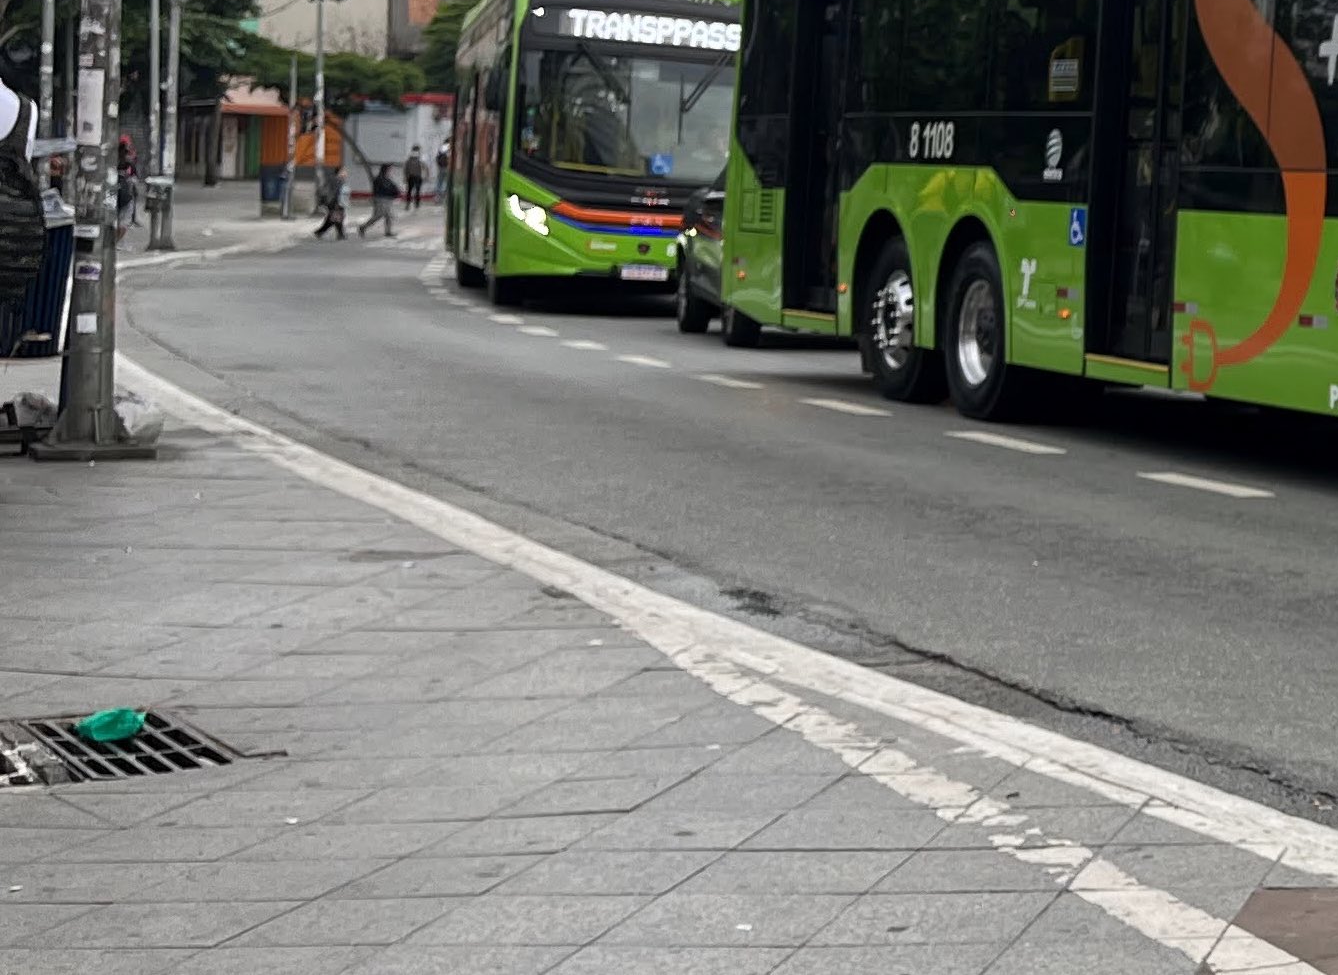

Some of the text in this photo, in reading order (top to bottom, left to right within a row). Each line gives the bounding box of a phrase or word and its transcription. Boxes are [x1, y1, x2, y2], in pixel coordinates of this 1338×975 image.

[567, 8, 743, 52] TRANSPPASS
[909, 120, 955, 160] 8 1108
